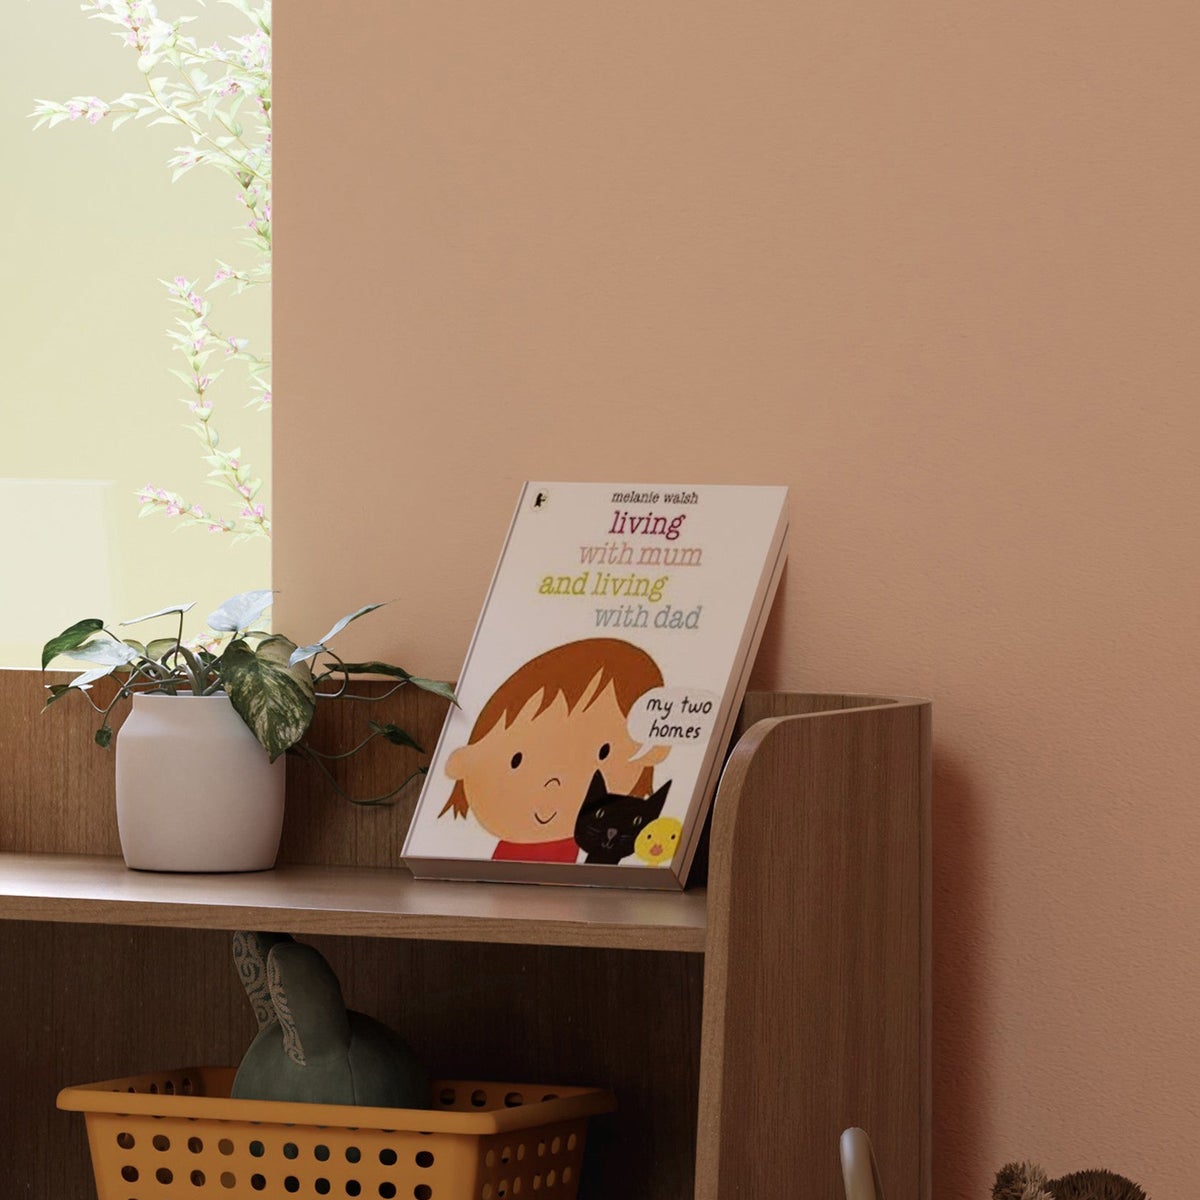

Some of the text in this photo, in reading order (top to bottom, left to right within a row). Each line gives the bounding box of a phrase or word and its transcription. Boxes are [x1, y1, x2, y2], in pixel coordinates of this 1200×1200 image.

[611, 491, 698, 504] melanie walsh
[608, 511, 686, 540] living
[580, 543, 702, 567] with mum
[538, 572, 668, 602] and living
[594, 605, 703, 630] with dad
[646, 696, 712, 720] my two
[648, 720, 702, 739] homes
